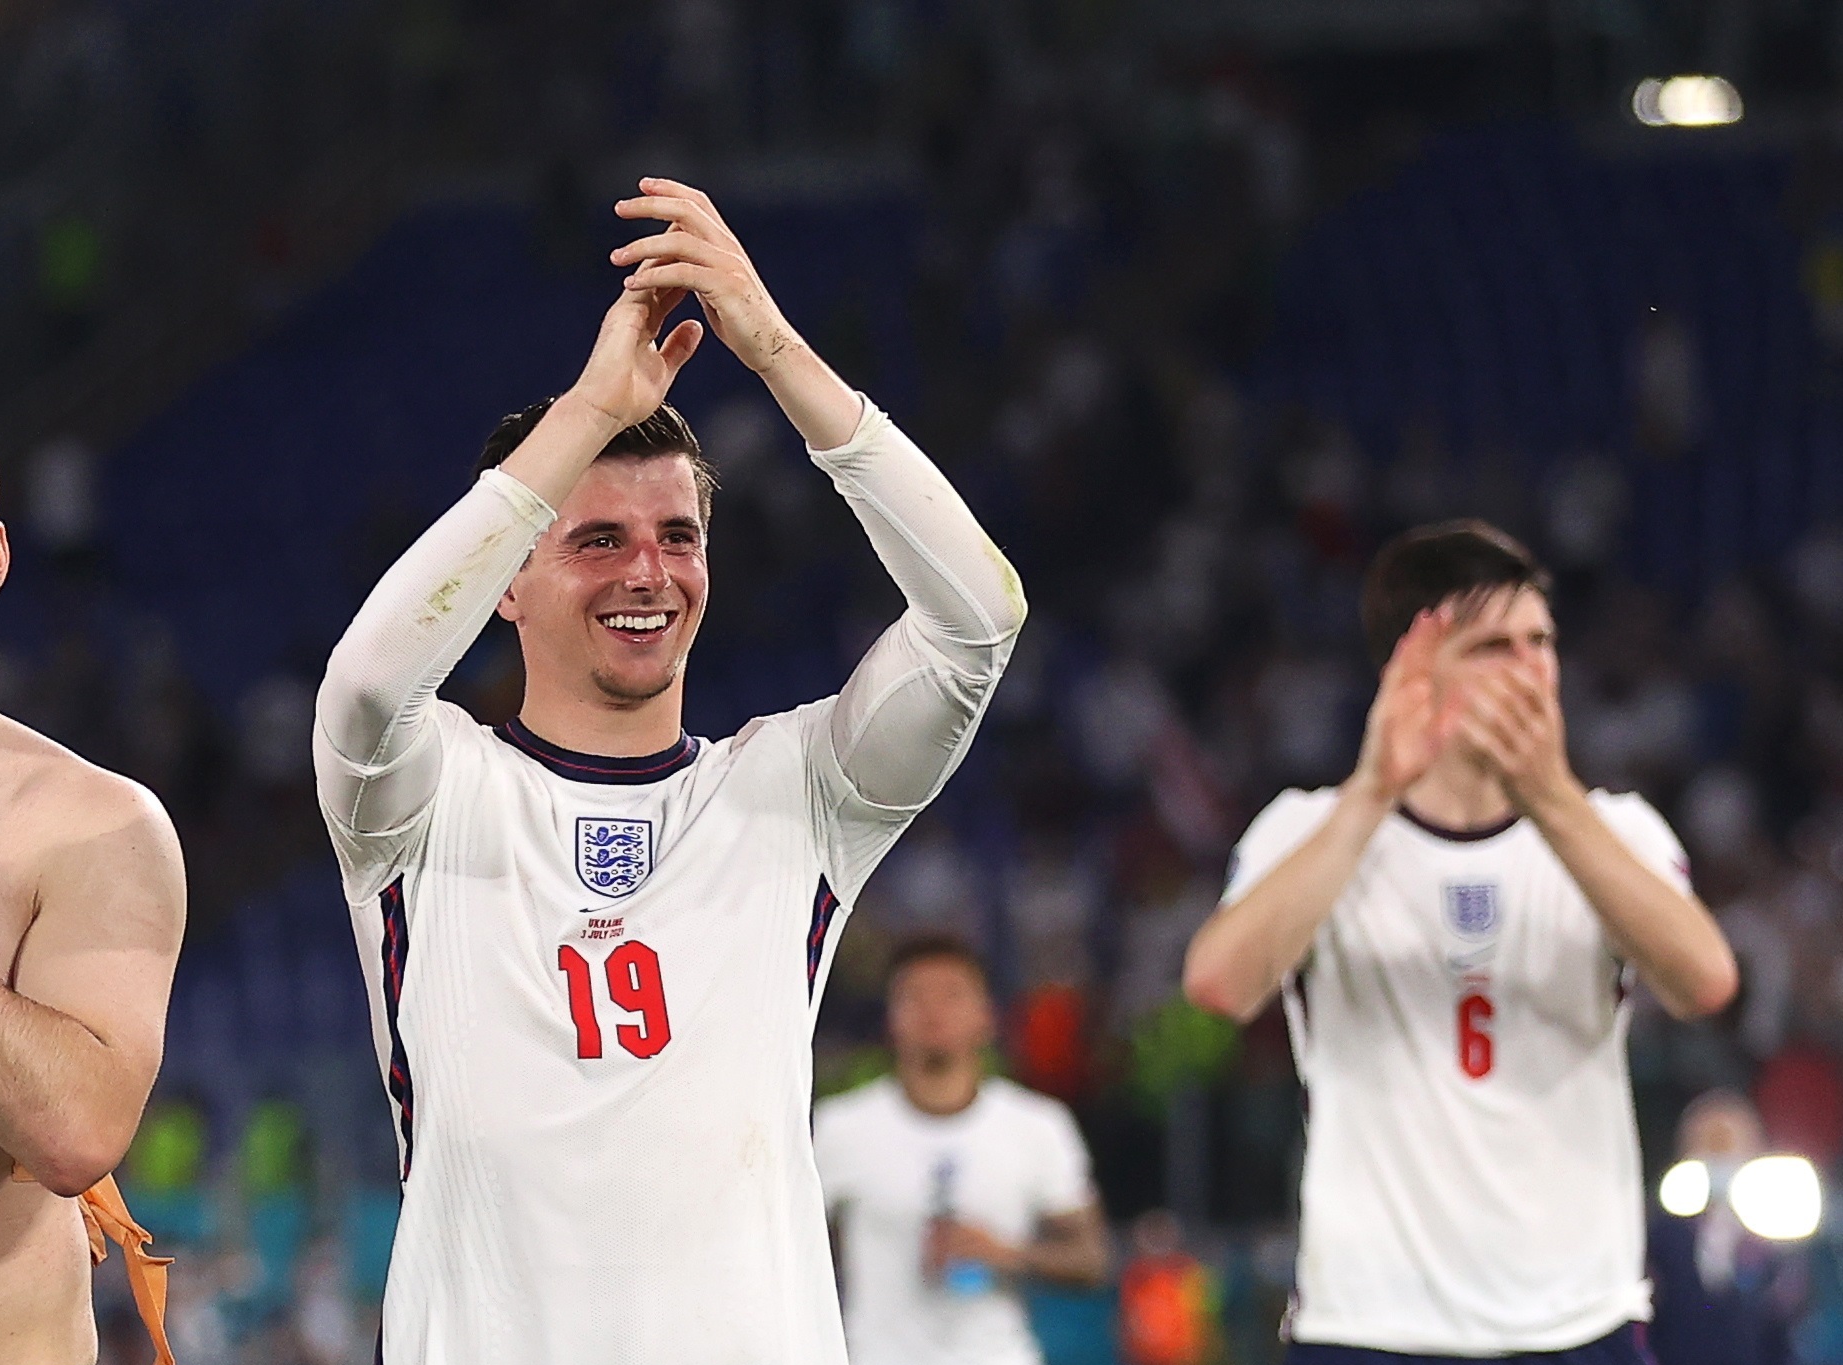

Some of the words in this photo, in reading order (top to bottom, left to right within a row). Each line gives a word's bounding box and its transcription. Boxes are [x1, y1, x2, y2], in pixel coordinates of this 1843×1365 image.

[580, 929, 587, 939] 3
[587, 930, 609, 940] JULY
[588, 917, 624, 928] UKRAINE
[558, 940, 672, 1060] 19
[1458, 993, 1494, 1080] 6
